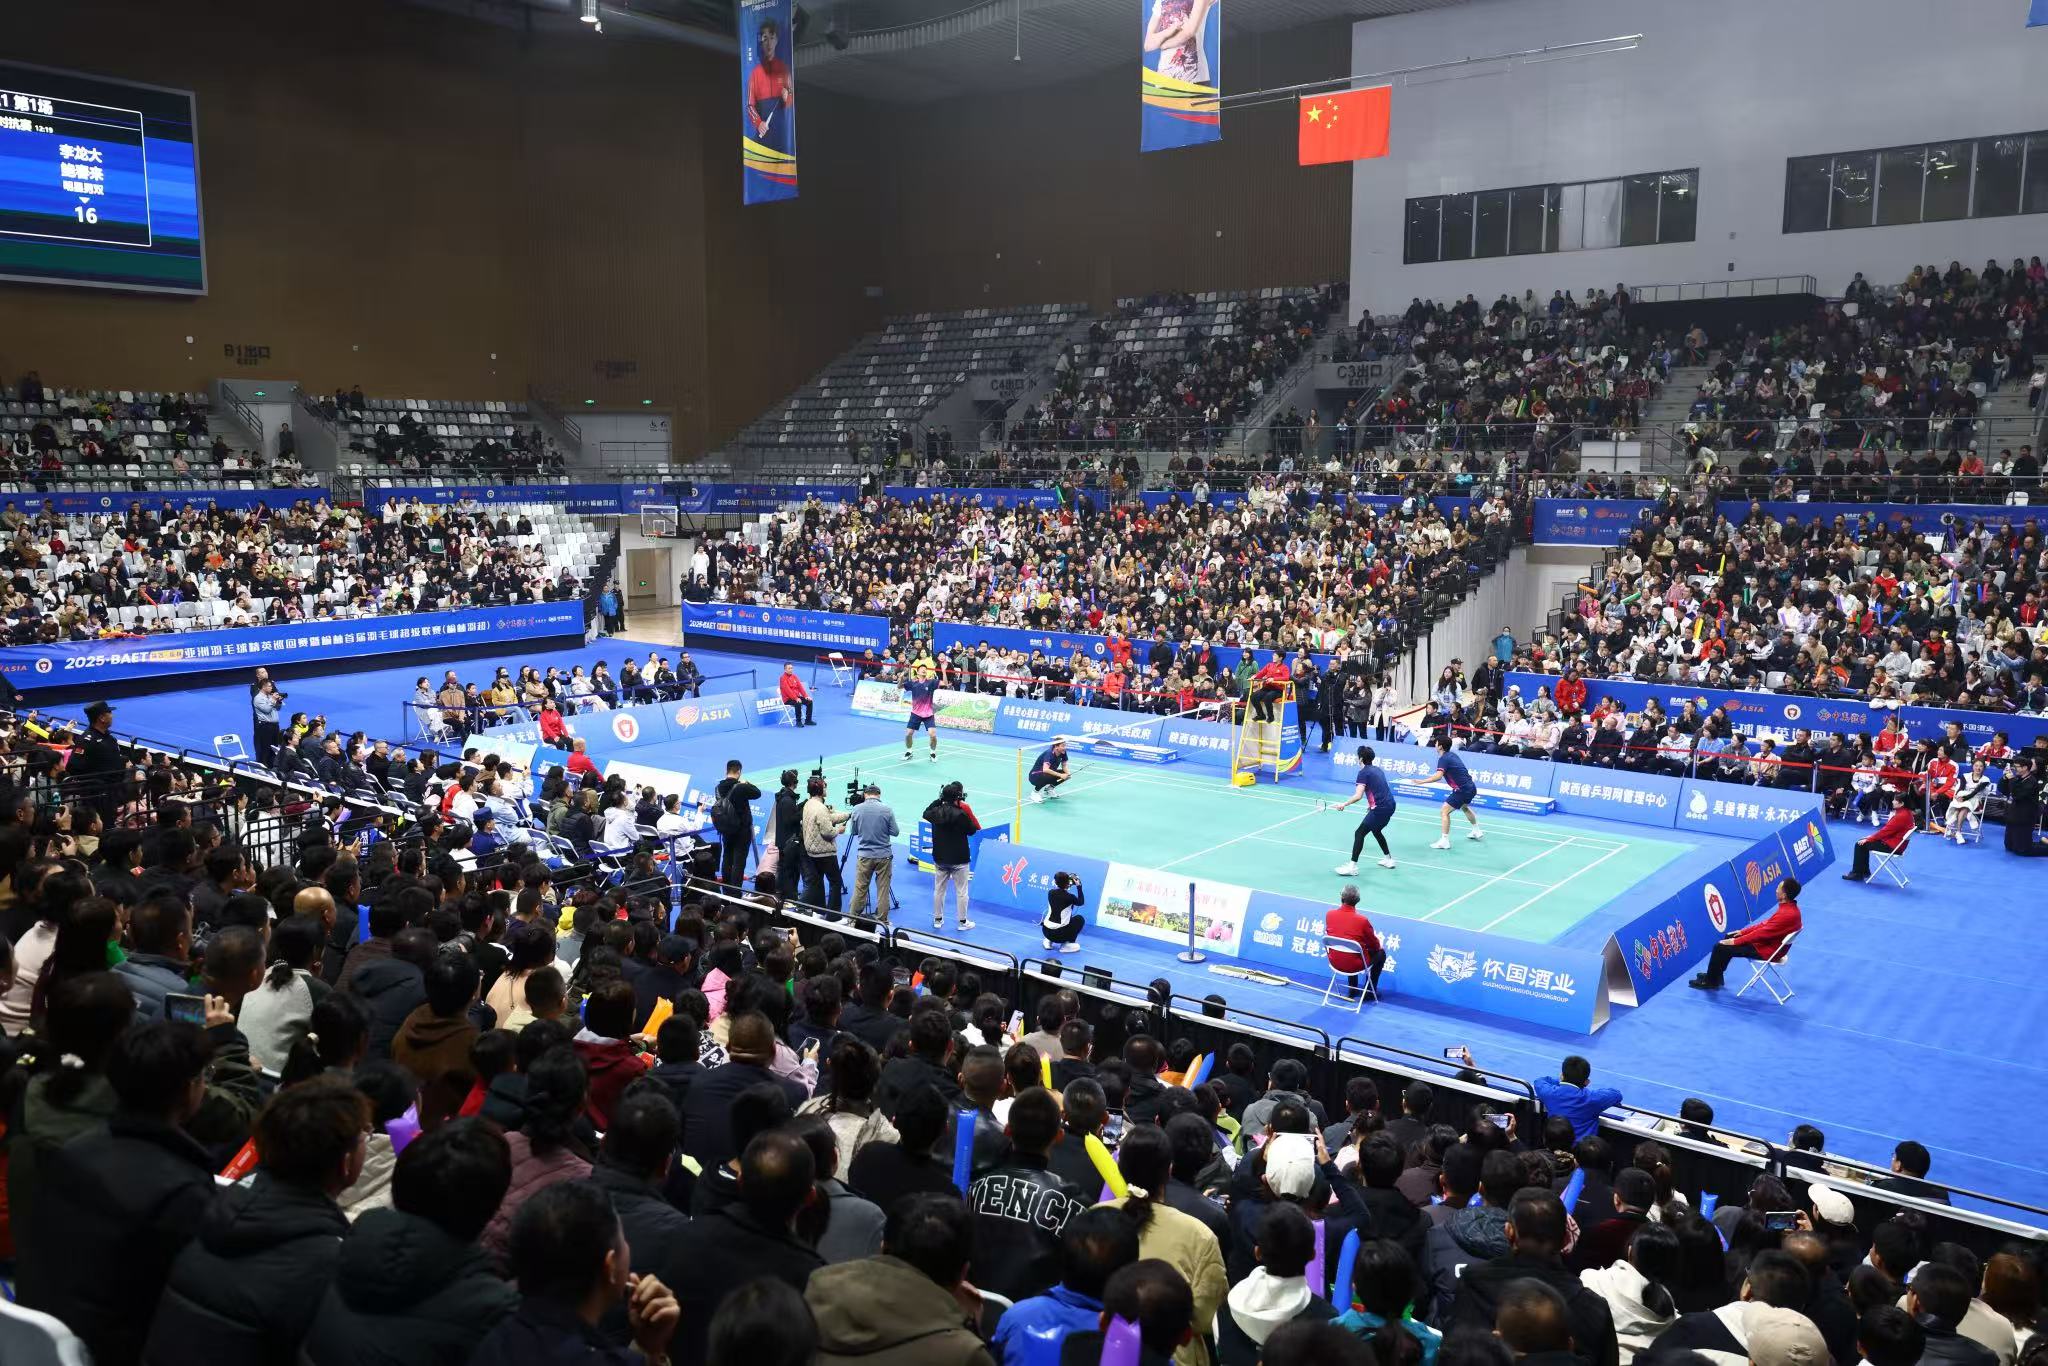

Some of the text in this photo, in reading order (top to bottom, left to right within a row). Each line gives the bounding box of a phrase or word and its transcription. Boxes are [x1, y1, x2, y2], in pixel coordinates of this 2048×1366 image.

[13, 94, 54, 116] 第1场
[74, 206, 98, 224] 16
[1337, 364, 1382, 378] C3出口
[701, 708, 732, 722] ASIA
[1741, 705, 1764, 713] ASIA
[1169, 731, 1230, 751] 陕西省体育局
[1559, 780, 1667, 808] 陕西省乒羽网管理中心
[1793, 835, 1810, 857] BAET
[1762, 862, 1782, 886] ASIA
[1482, 958, 1576, 996] 怀国酒业
